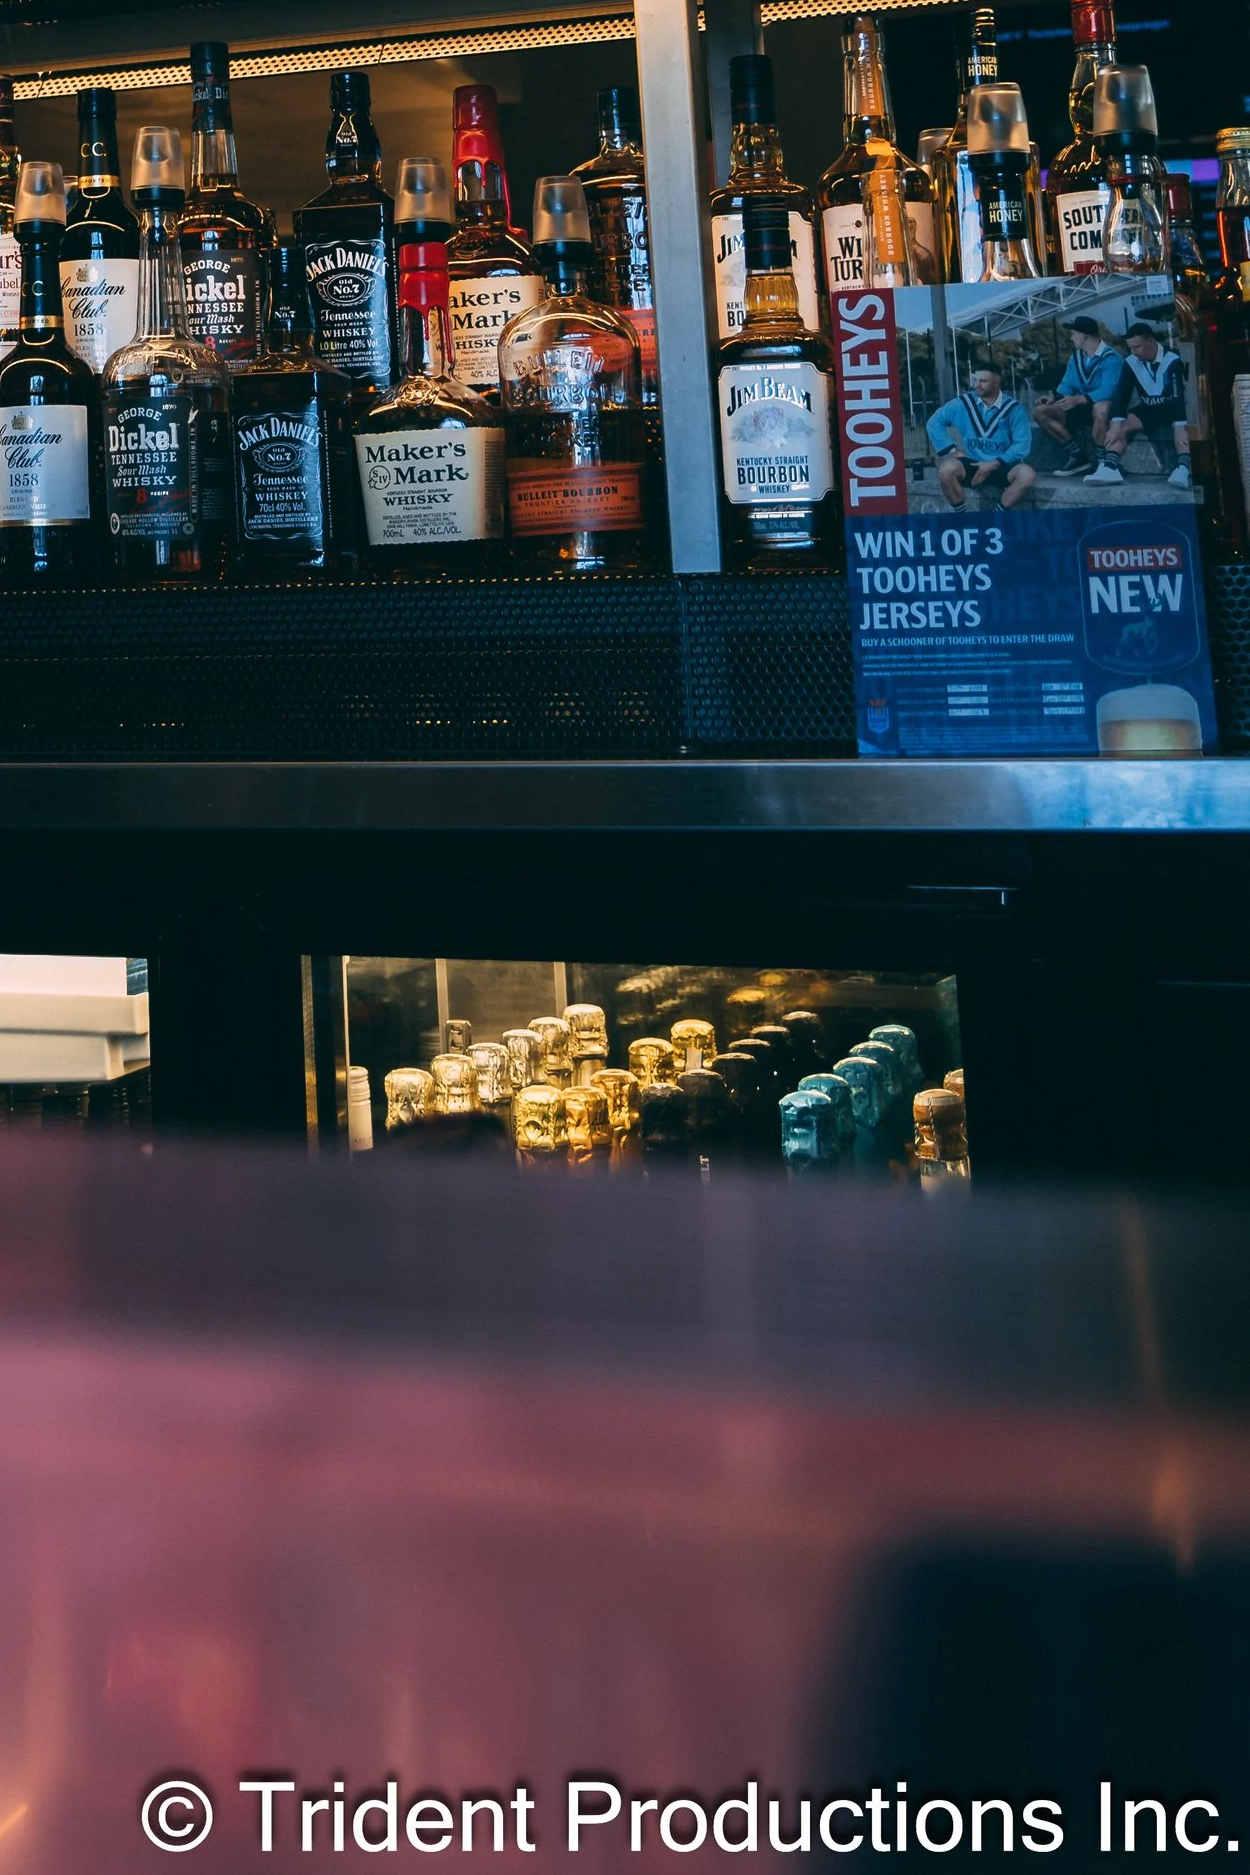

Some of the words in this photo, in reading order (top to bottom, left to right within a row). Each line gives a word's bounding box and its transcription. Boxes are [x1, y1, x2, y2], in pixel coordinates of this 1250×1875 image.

[967, 56, 998, 65] AMERICAN
[967, 64, 998, 77] HONEY
[989, 201, 1022, 210] AMERICAN
[989, 208, 1023, 224] HONEY
[883, 214, 895, 256] BOURBON
[184, 259, 230, 276] GEORGE
[305, 253, 337, 283] JACK
[335, 246, 390, 277] DANIEL'S
[61, 275, 125, 301] Canadian
[186, 274, 246, 302] ickel
[333, 284, 360, 295] No.7
[206, 314, 235, 325] Mash
[274, 310, 296, 319] No.7
[320, 309, 377, 322] Tennessee
[74, 323, 104, 337] 1858
[322, 327, 377, 339] WHISKEY
[204, 336, 216, 351] 8
[330, 339, 348, 351] Litre
[348, 338, 366, 349] 40%
[726, 381, 759, 417] JIM
[759, 376, 813, 413] BEAM
[838, 294, 897, 507] TOOHEYS
[117, 406, 163, 424] GEORGE
[108, 422, 180, 453] Dickel
[237, 423, 271, 451] JACK
[269, 417, 324, 449] DANIEL'S
[965, 436, 1012, 453] TOOHEYS
[111, 451, 177, 466] TENNESSEE
[267, 452, 292, 463] No.7
[364, 441, 467, 464] Maker's
[736, 456, 772, 466] KENTUCKY
[774, 455, 809, 465] STRAIGHT
[116, 465, 138, 477] Sour
[138, 464, 167, 476] Mash
[393, 463, 470, 486] Mark
[737, 464, 810, 485] BOURBON
[9, 473, 39, 487] 1858
[111, 475, 177, 488] WHISKY
[253, 473, 309, 487] Tennessee
[135, 488, 148, 504] 8
[517, 489, 558, 502] BULLEIT
[562, 485, 619, 499] BOURBON
[758, 483, 791, 494] WHISKEY
[254, 491, 309, 502] WHISKEY
[382, 492, 454, 507] WHISKY
[524, 499, 566, 507] FRONTIER
[259, 503, 275, 513] 70cl
[275, 502, 292, 513] 40%
[402, 504, 434, 512] Handmade
[247, 517, 263, 525] JACK
[284, 515, 320, 523] DISTILLERY
[382, 528, 405, 539] 700mL
[412, 527, 428, 537] 40%
[854, 529, 915, 559] WIN
[921, 529, 936, 556] 1
[940, 528, 979, 557] OF
[984, 526, 1004, 555] 3
[1089, 547, 1179, 569] TOOHEYS
[856, 563, 993, 595] TOOHEYS
[1088, 573, 1184, 615] NEW
[859, 599, 982, 631] JERSEYS
[861, 638, 880, 647] BUY
[880, 637, 887, 646] A
[887, 635, 934, 647] SCHOONER
[934, 635, 947, 645] OF
[947, 634, 987, 646] TOOHEYS
[988, 634, 1000, 644] TO
[1000, 633, 1029, 644] ENTER
[1029, 633, 1047, 643] THE
[1047, 632, 1076, 644] DRAW
